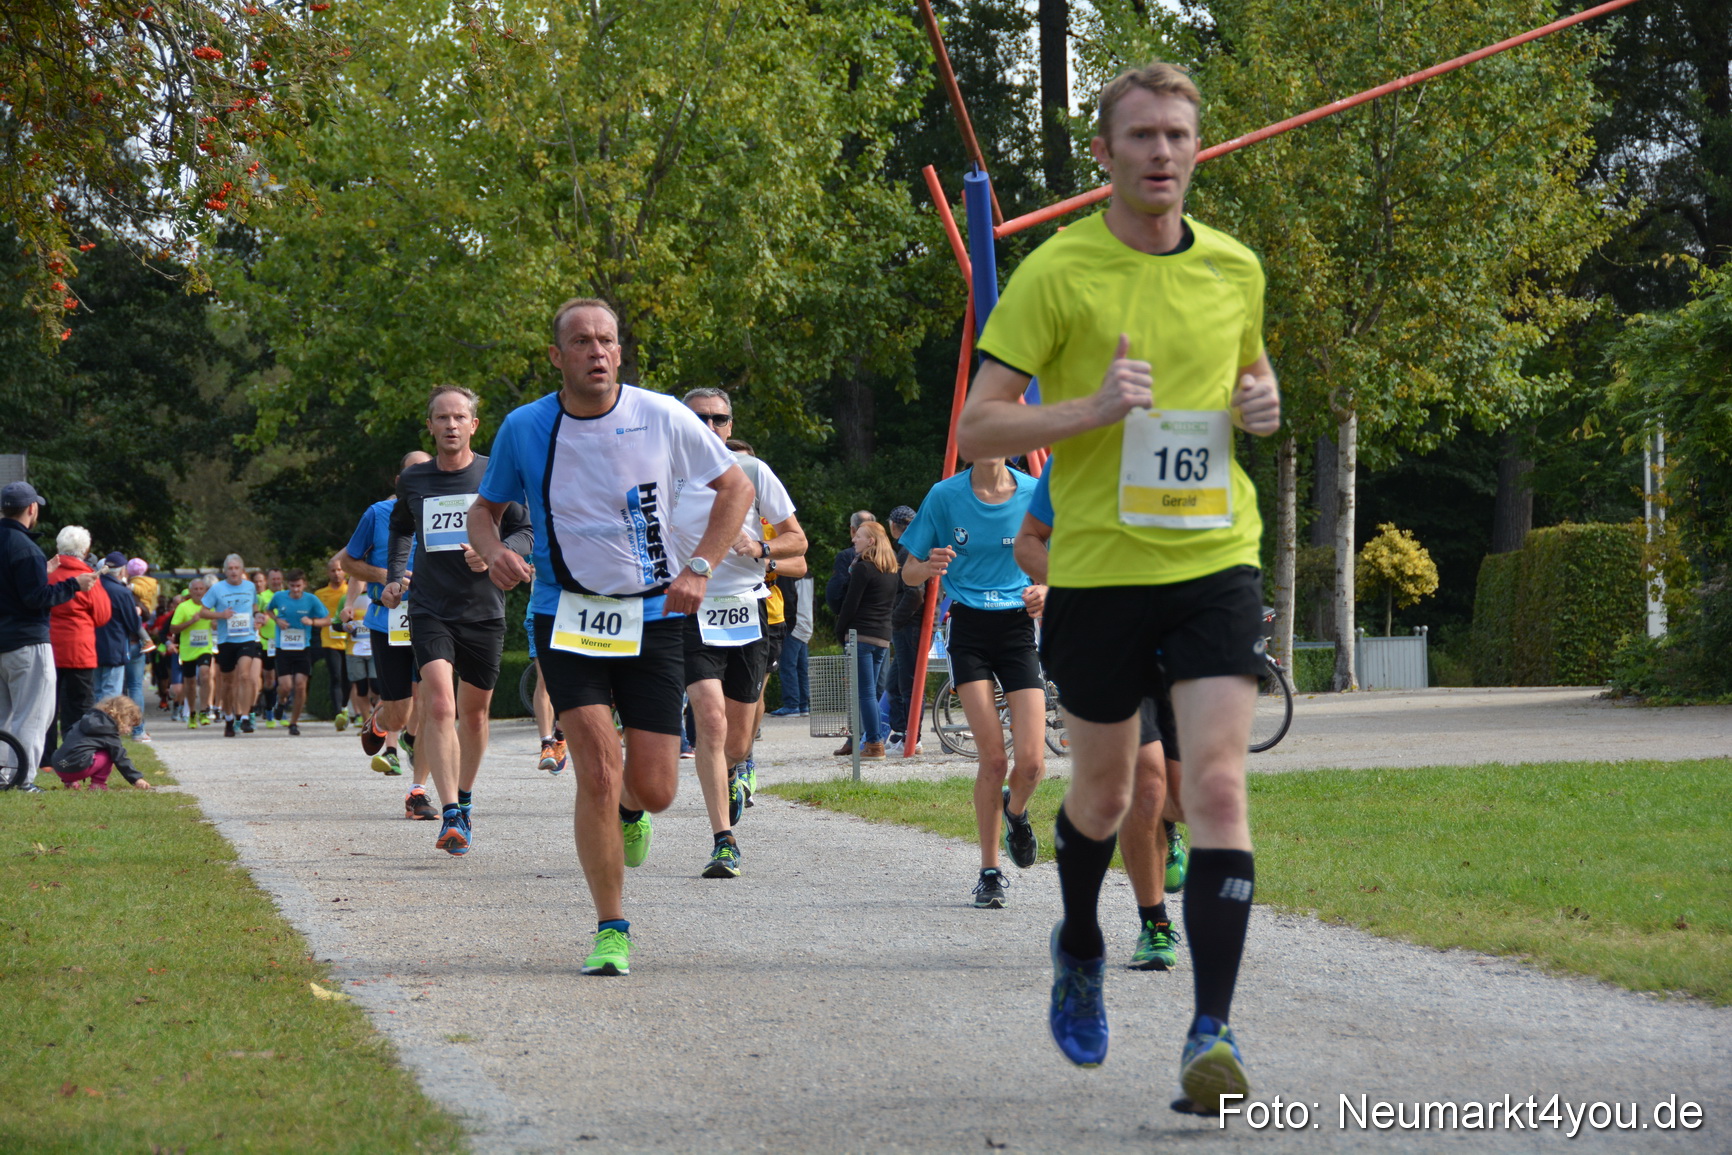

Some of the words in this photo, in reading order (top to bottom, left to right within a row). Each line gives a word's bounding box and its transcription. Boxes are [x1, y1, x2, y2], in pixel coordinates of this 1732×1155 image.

[1154, 446, 1210, 482] 163
[1162, 494, 1197, 507] Gerald
[431, 511, 467, 530] 273
[620, 508, 633, 532] WASTE
[638, 481, 671, 582] HUBER
[630, 507, 652, 580] TECHNOLOGY
[578, 609, 622, 636] 140
[706, 606, 750, 626] 2768
[581, 638, 612, 648] Werner
